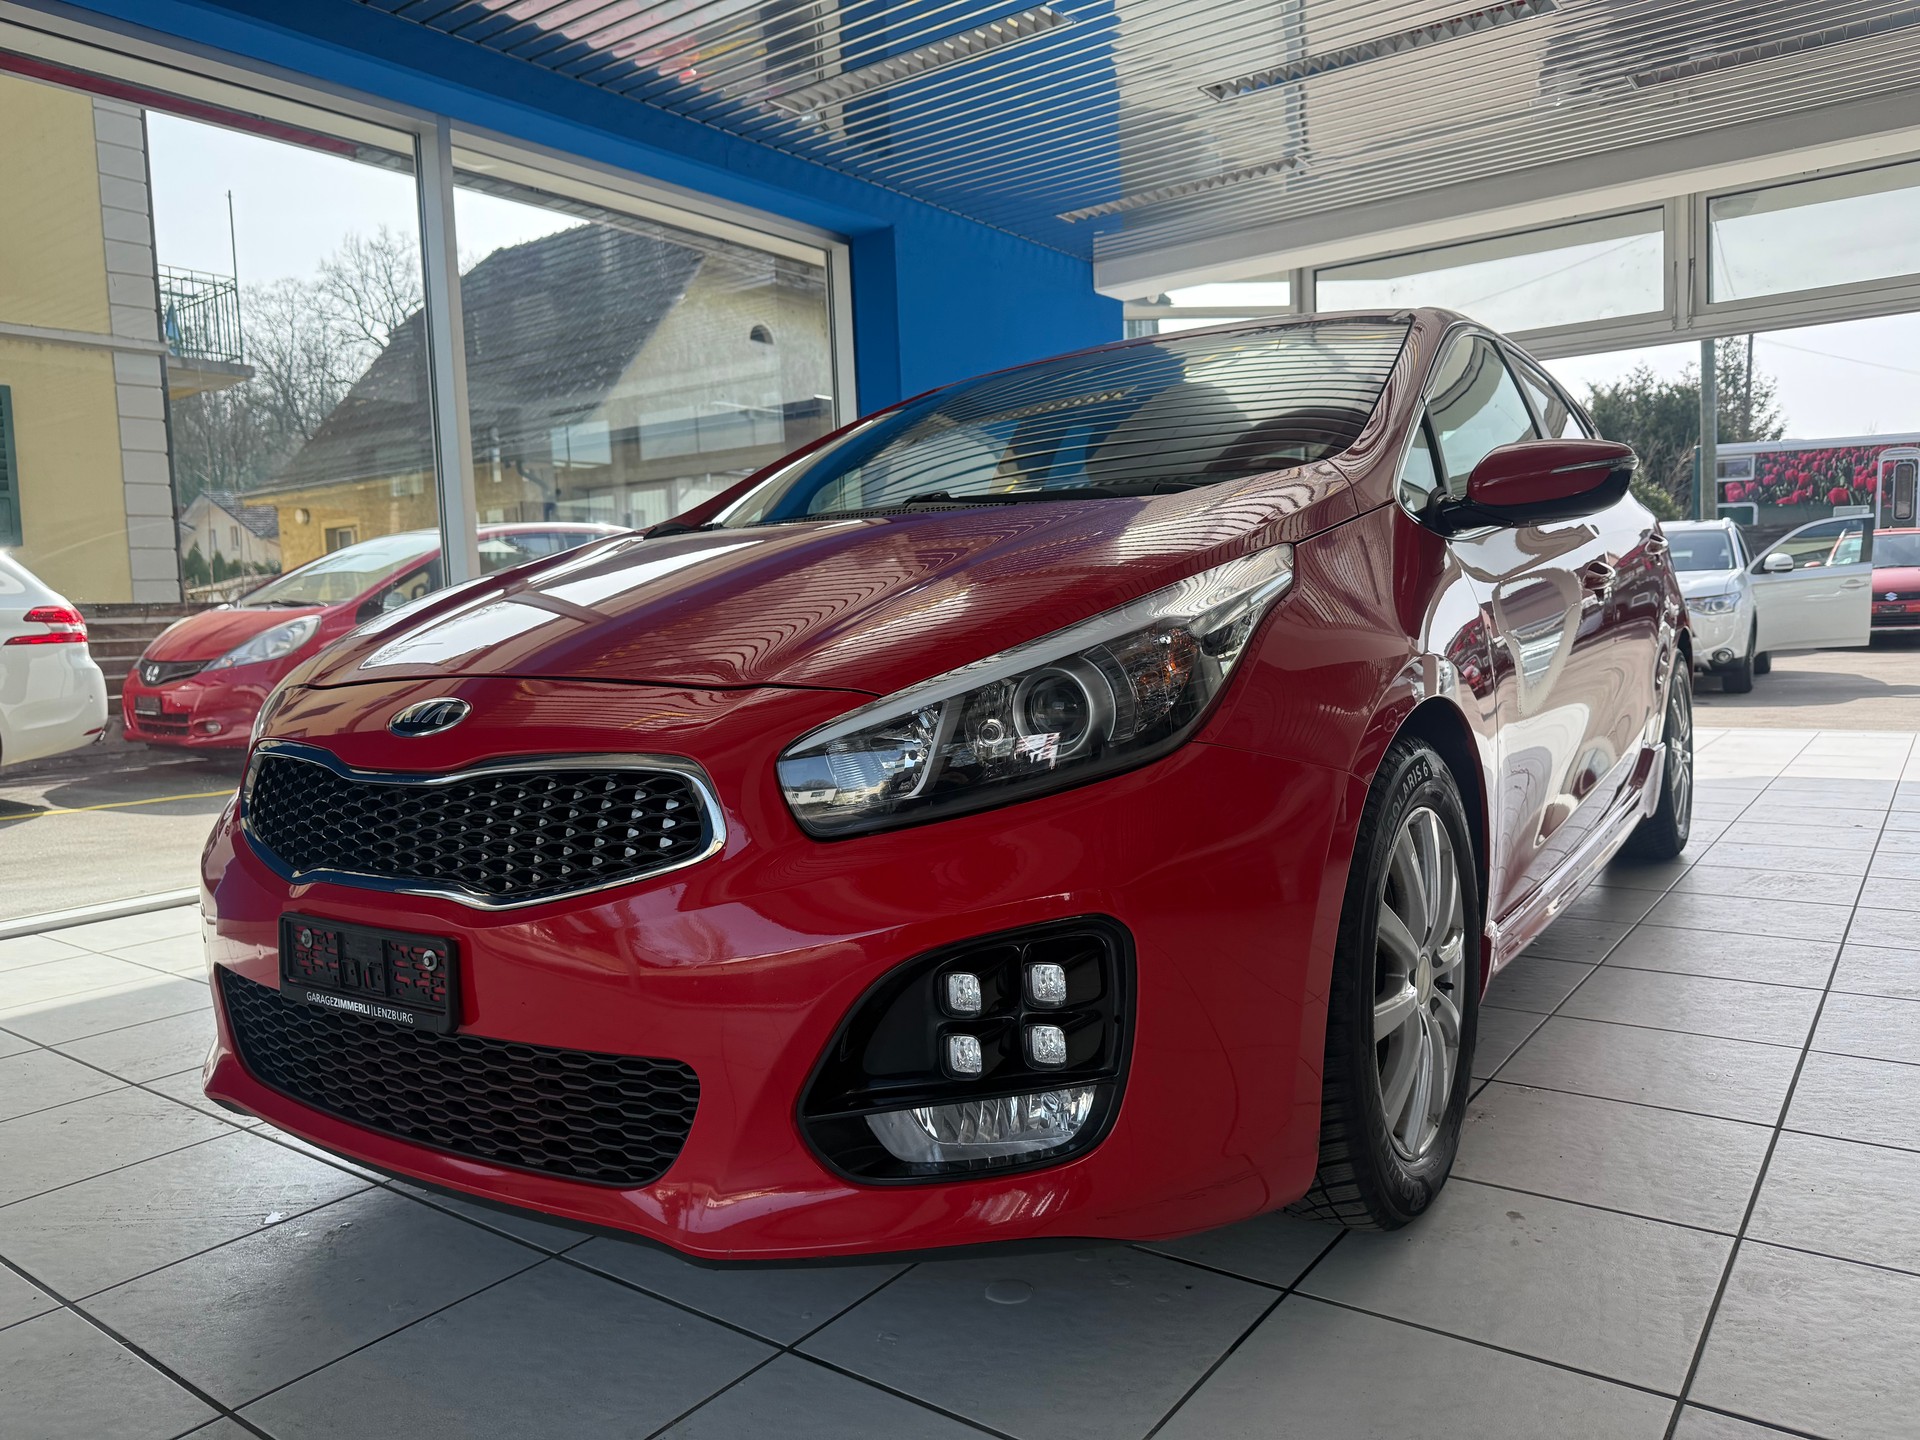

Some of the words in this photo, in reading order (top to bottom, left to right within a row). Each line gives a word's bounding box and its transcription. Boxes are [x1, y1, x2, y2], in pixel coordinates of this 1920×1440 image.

[395, 702, 454, 725] KIA
[1387, 764, 1422, 831] POLARIS
[1422, 761, 1430, 777] 6
